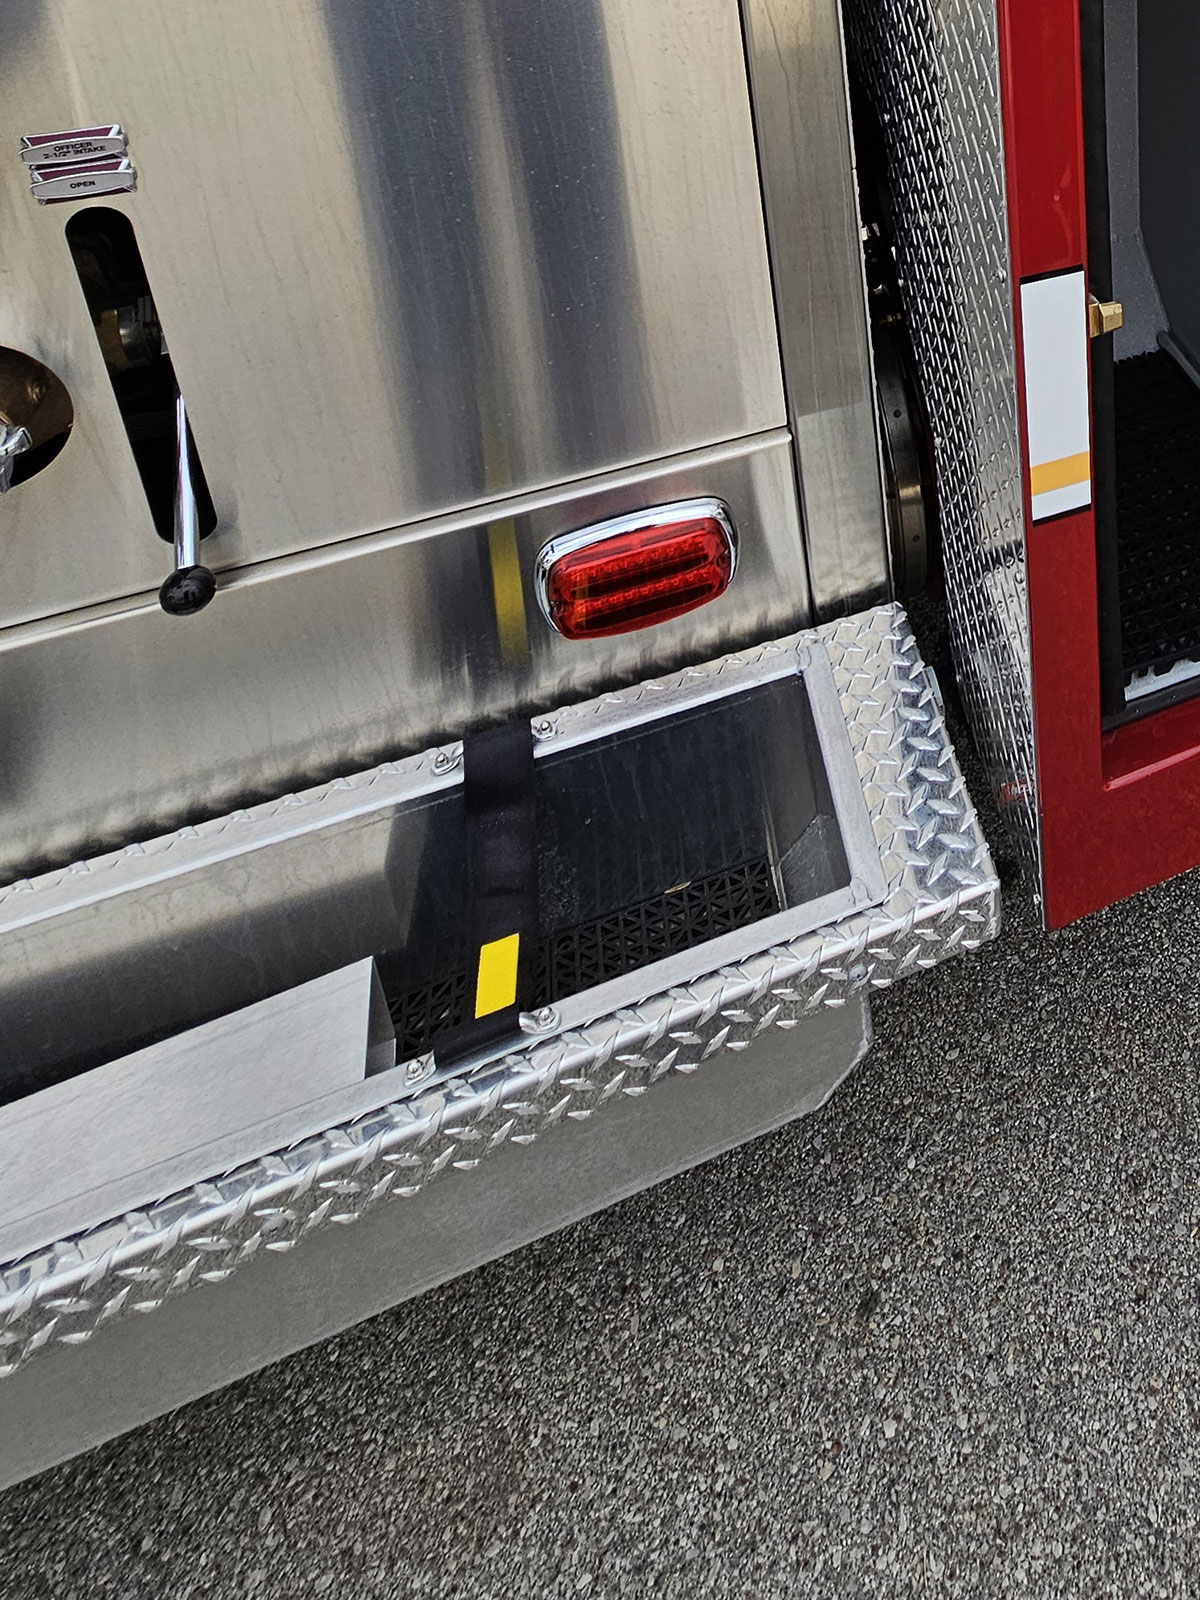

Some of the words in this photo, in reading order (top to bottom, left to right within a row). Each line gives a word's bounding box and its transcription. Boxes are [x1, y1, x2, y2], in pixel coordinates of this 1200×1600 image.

[53, 142, 93, 152] OFFICER
[74, 145, 107, 155] INTAKE
[69, 180, 96, 189] OPEN
